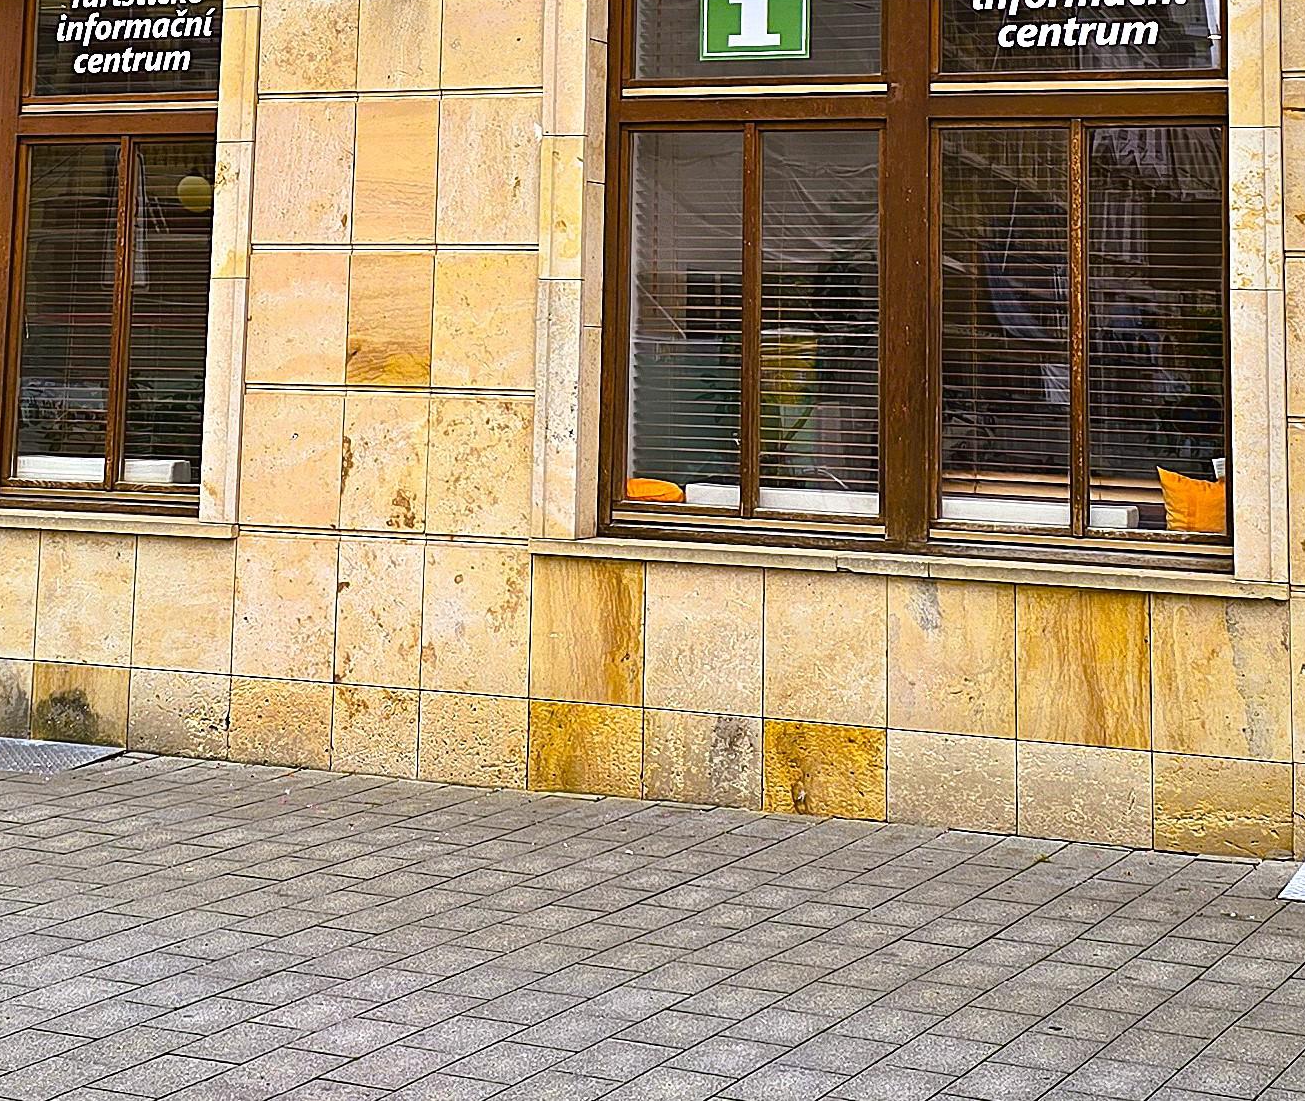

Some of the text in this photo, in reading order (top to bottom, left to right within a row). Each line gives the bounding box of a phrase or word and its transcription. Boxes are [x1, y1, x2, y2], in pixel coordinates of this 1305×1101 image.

[56, 8, 216, 46] informační
[997, 17, 1159, 48] centrum
[74, 47, 191, 74] centrum
